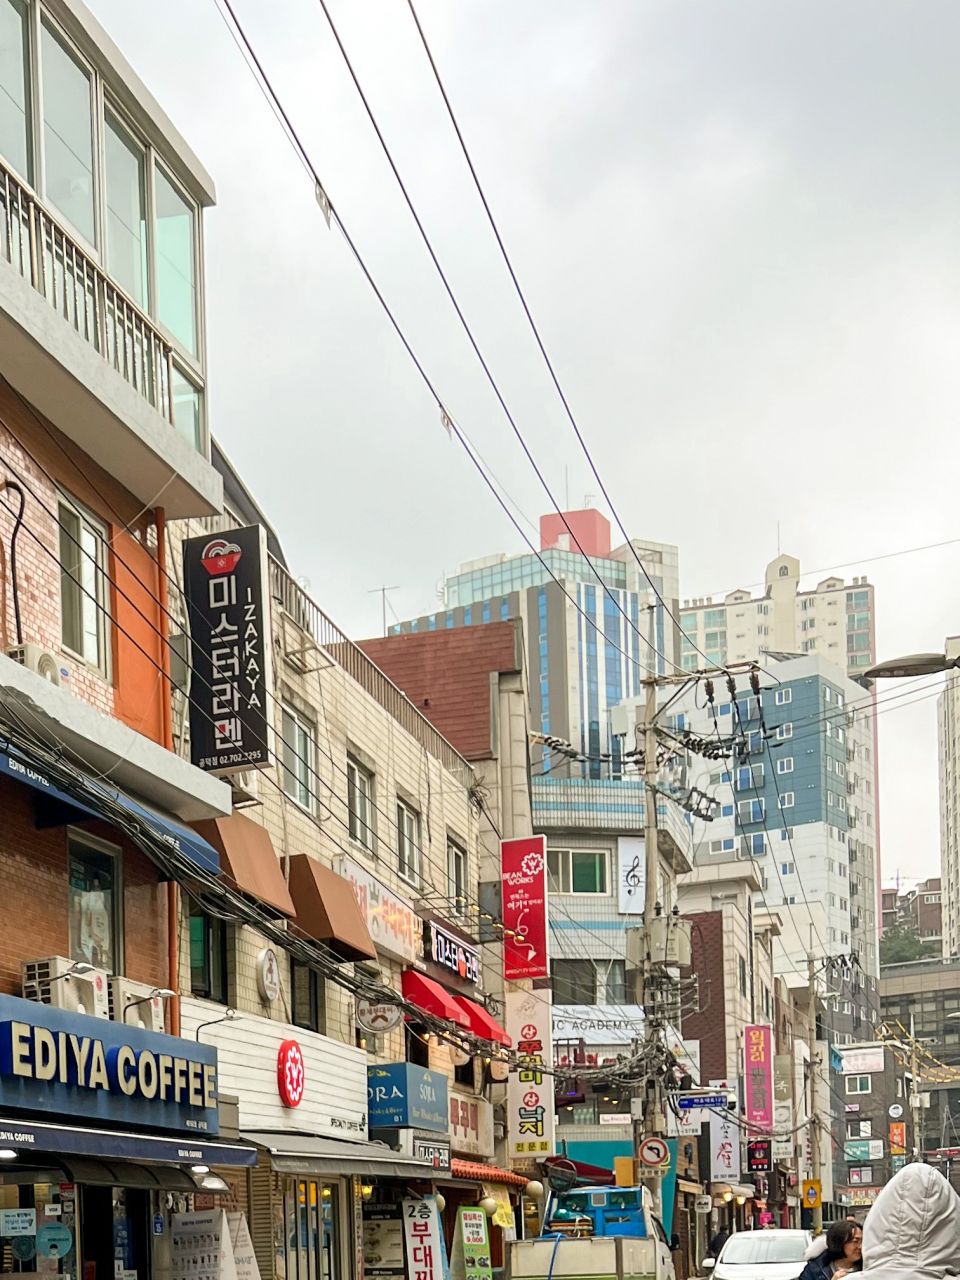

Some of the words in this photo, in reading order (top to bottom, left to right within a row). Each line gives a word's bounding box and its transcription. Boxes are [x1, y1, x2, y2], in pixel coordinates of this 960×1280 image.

[244, 587, 262, 709] IZAKAYA
[209, 575, 243, 749] 미스터라멘
[502, 872, 522, 880] BEAN
[507, 877, 534, 885] WORKS
[572, 1020, 629, 1031] ACADEMY
[11, 1020, 109, 1091] EDIYA
[117, 1045, 218, 1109] COFFEE
[14, 1132, 35, 1143] COFFEE
[407, 1202, 432, 1219] 2층
